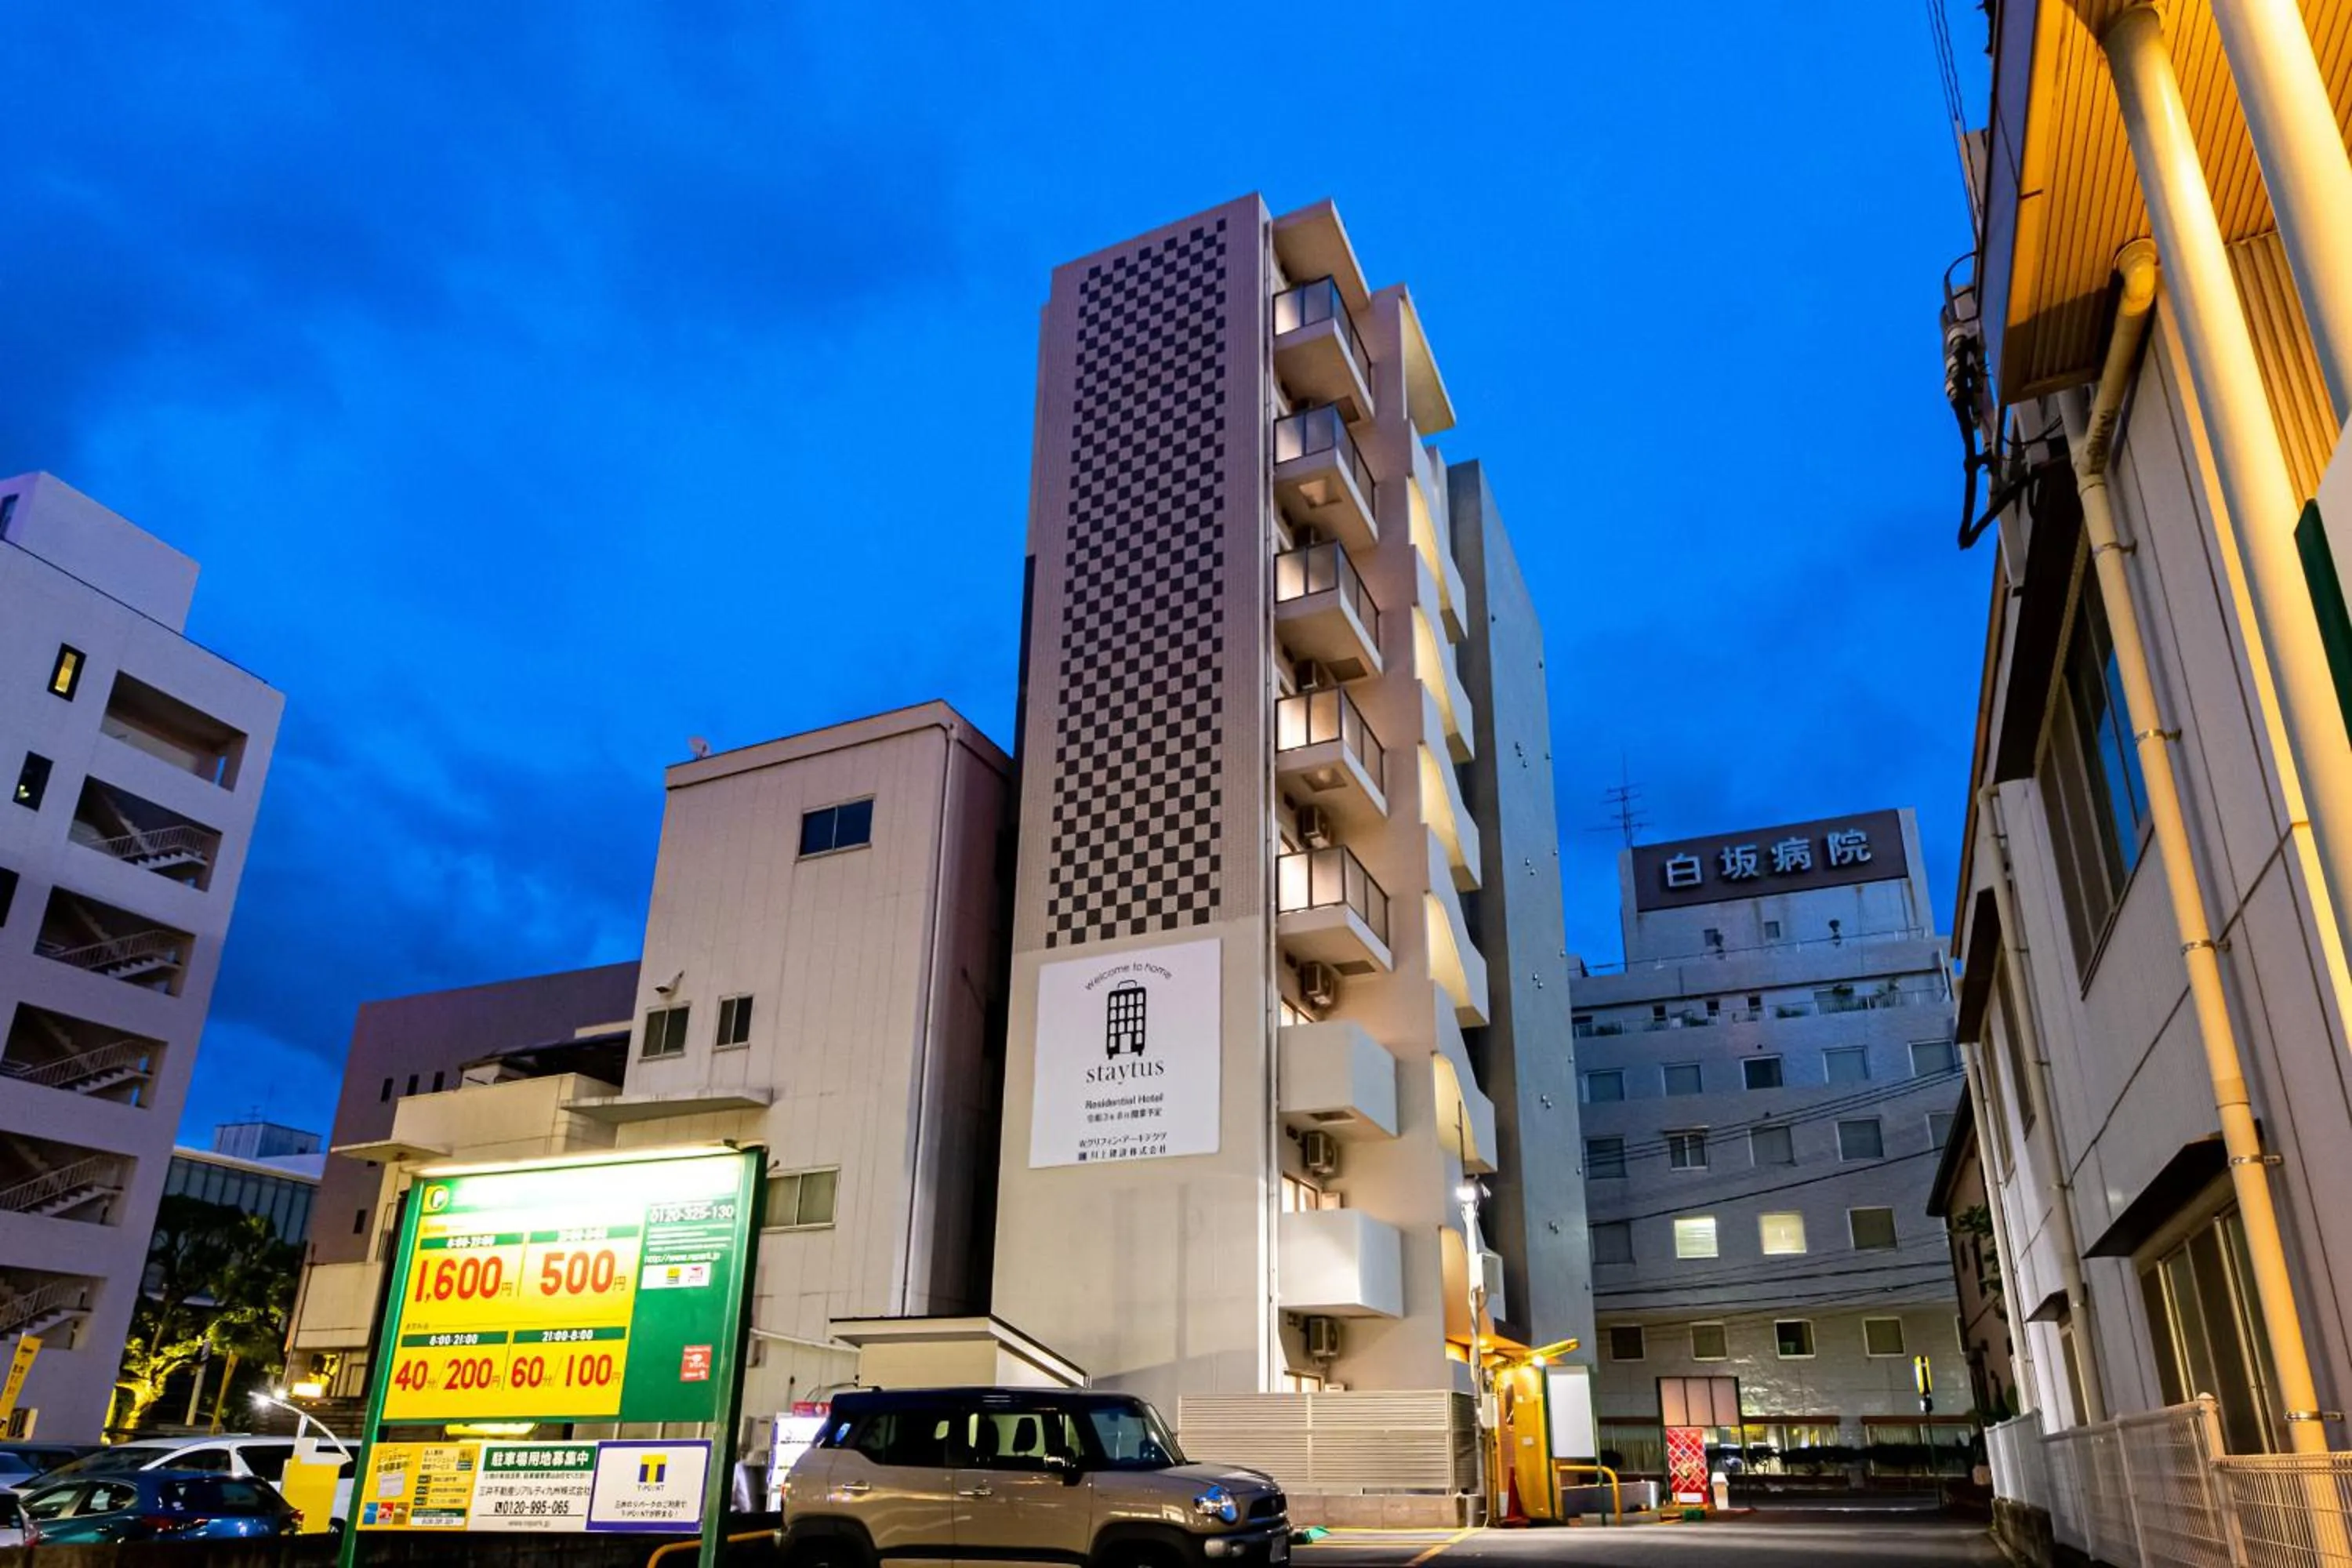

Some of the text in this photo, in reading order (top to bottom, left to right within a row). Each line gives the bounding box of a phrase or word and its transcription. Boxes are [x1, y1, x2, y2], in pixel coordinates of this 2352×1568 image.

[1665, 829, 1871, 887] 白坂病院
[1133, 962, 1143, 971] to
[1145, 962, 1173, 980] home
[1086, 1060, 1164, 1085] staytus
[1085, 1093, 1164, 1109] Residential Hotel
[491, 1450, 590, 1467] 駐車場用地募集中
[503, 1501, 570, 1515] 0120-995-065
